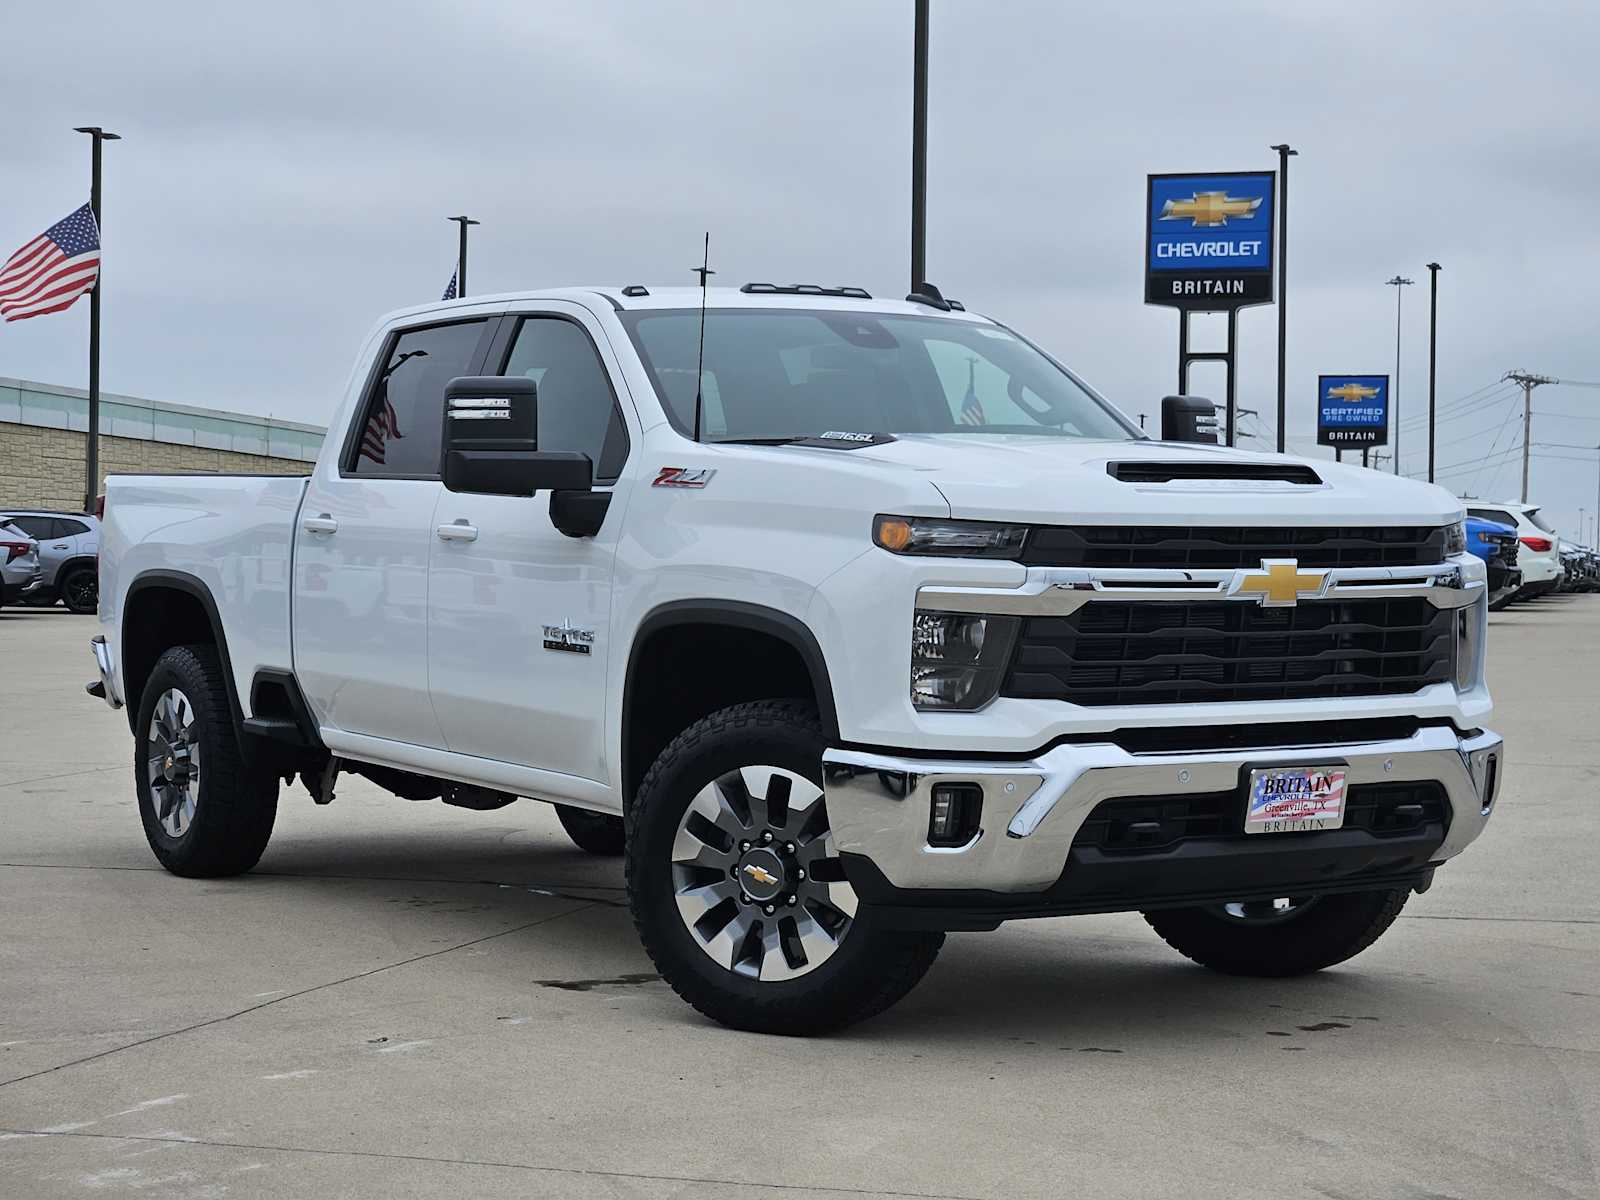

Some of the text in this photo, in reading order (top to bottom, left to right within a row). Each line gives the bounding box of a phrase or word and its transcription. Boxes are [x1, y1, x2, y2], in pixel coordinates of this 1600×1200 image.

[1157, 241, 1262, 258] CHEVROLET
[1172, 280, 1244, 294] BRITAIN
[1328, 432, 1375, 440] BRITAIN
[1264, 776, 1334, 794] BRITAIN
[1262, 793, 1312, 802] CHEVROLET
[1264, 801, 1326, 813] Greenville, TX
[1264, 819, 1325, 832] BRITAIN
